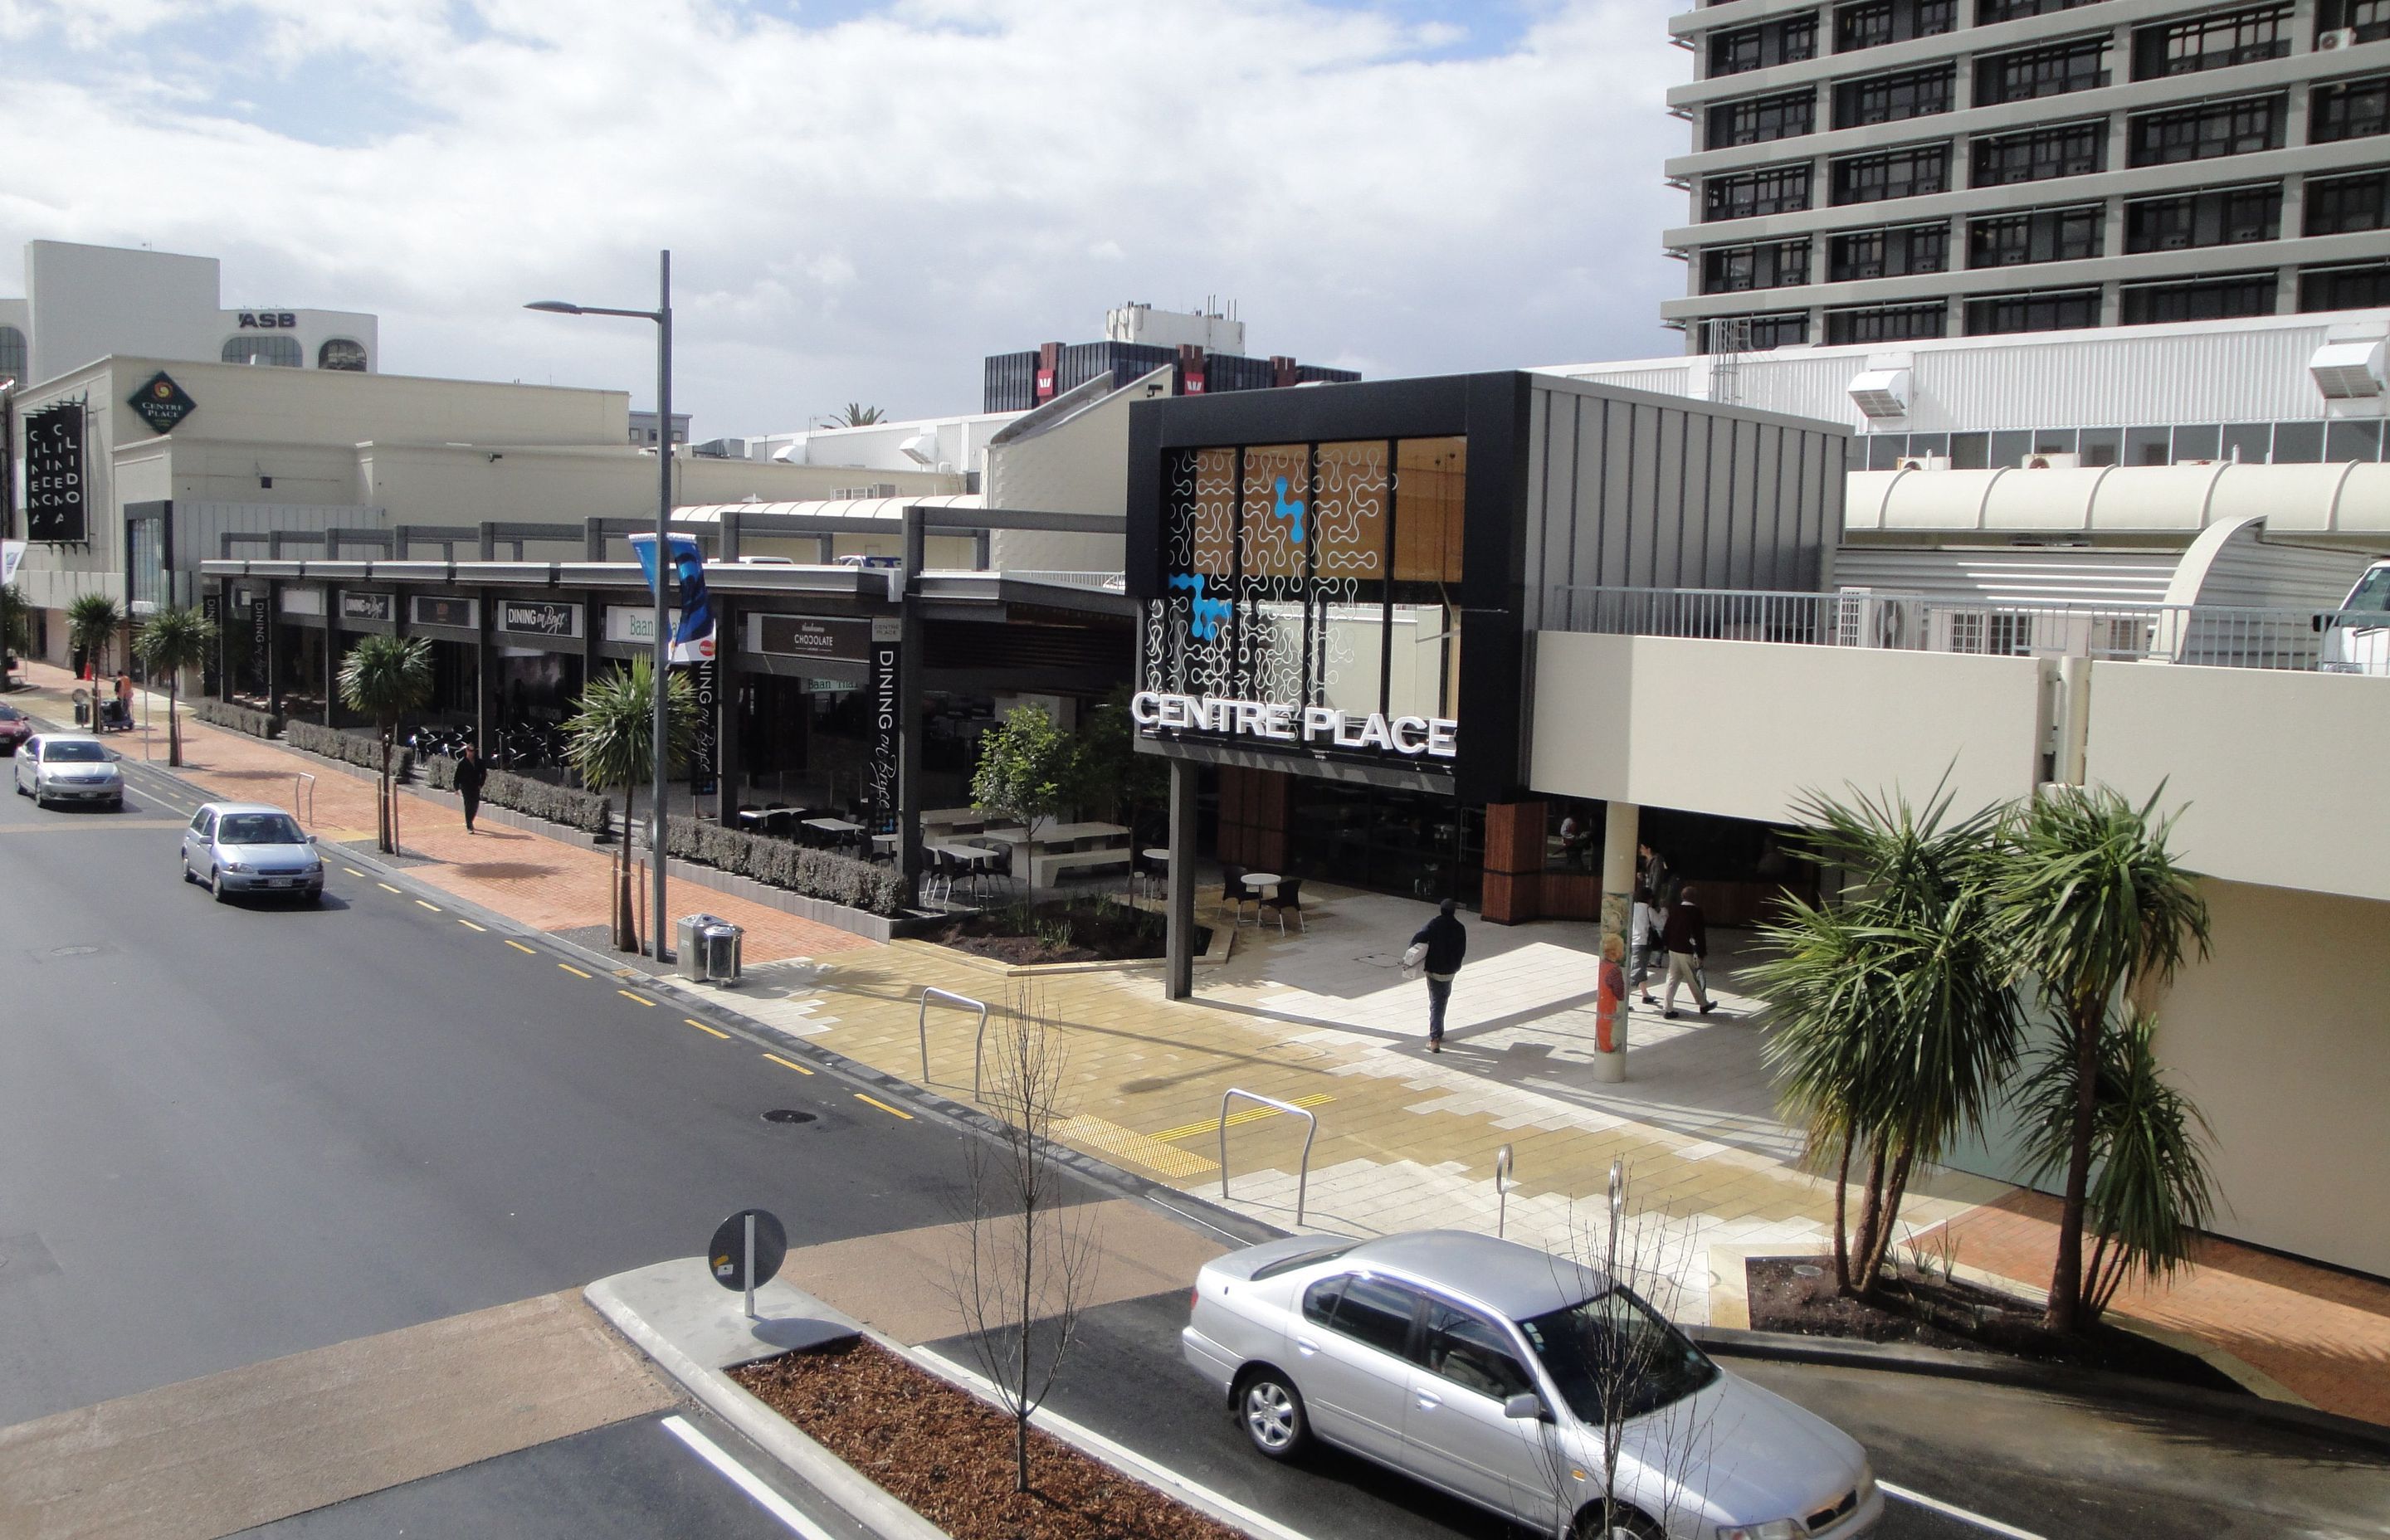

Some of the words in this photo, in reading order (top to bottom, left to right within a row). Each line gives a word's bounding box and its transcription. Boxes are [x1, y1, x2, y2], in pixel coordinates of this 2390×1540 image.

[239, 313, 296, 329] ASB
[66, 436, 80, 504] LIDO
[256, 602, 265, 643] DINING
[508, 608, 537, 625] DINING
[631, 614, 654, 637] Baan
[699, 660, 713, 704] NING
[807, 679, 831, 690] Baan
[878, 651, 894, 730] DINING
[1131, 691, 1296, 740] CENTRE
[1304, 706, 1458, 758] PLACE
[870, 753, 897, 809] Bryce
